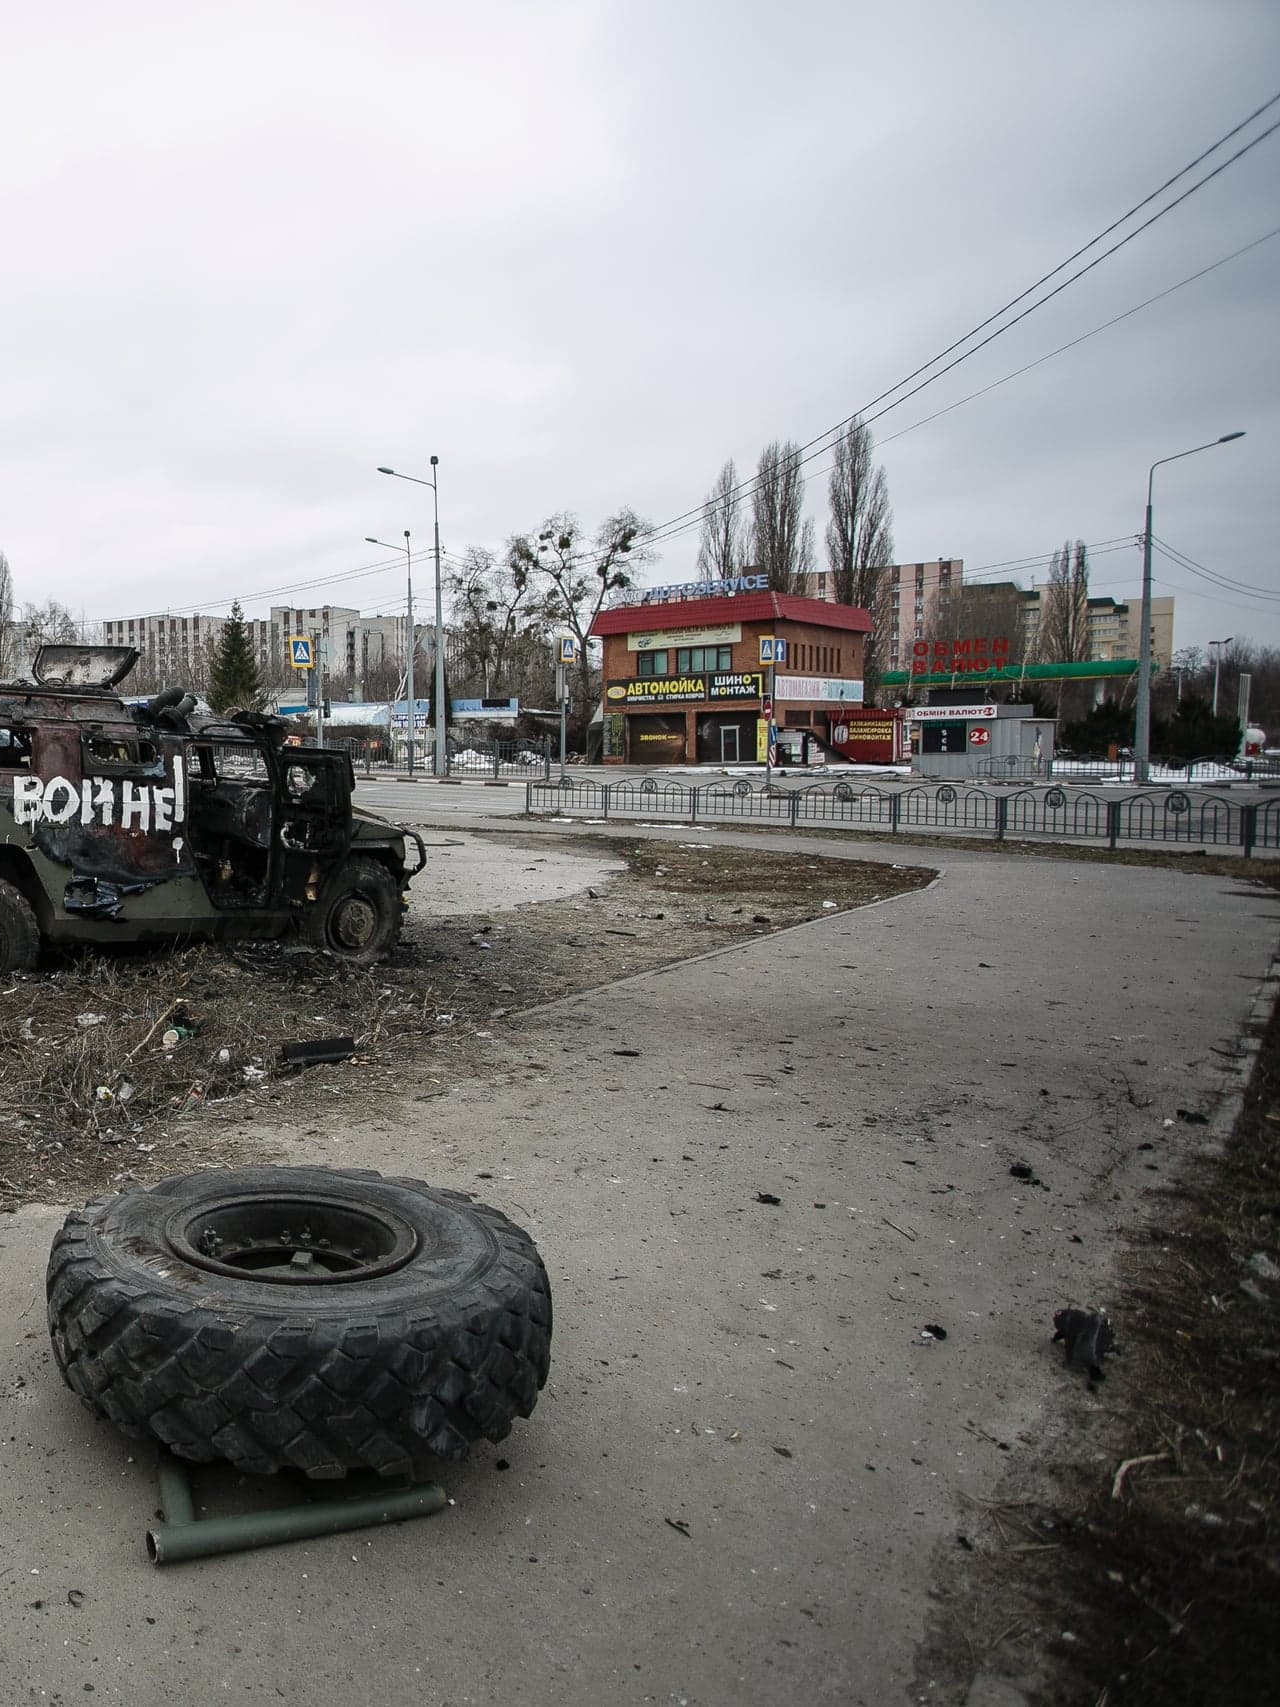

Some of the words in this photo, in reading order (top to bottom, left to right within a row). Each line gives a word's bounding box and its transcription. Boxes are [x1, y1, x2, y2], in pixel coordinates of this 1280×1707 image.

[913, 637, 1009, 656] ОБМЕН
[912, 657, 1008, 675] ВАЛЮТ
[714, 674, 752, 686] ШИНО
[627, 677, 705, 696] АВТОМОЙКА
[711, 685, 756, 696] МОНТАЖ
[916, 709, 946, 717] ОБМІН
[948, 708, 983, 716] ВАЛЮТ
[970, 731, 989, 742] 24
